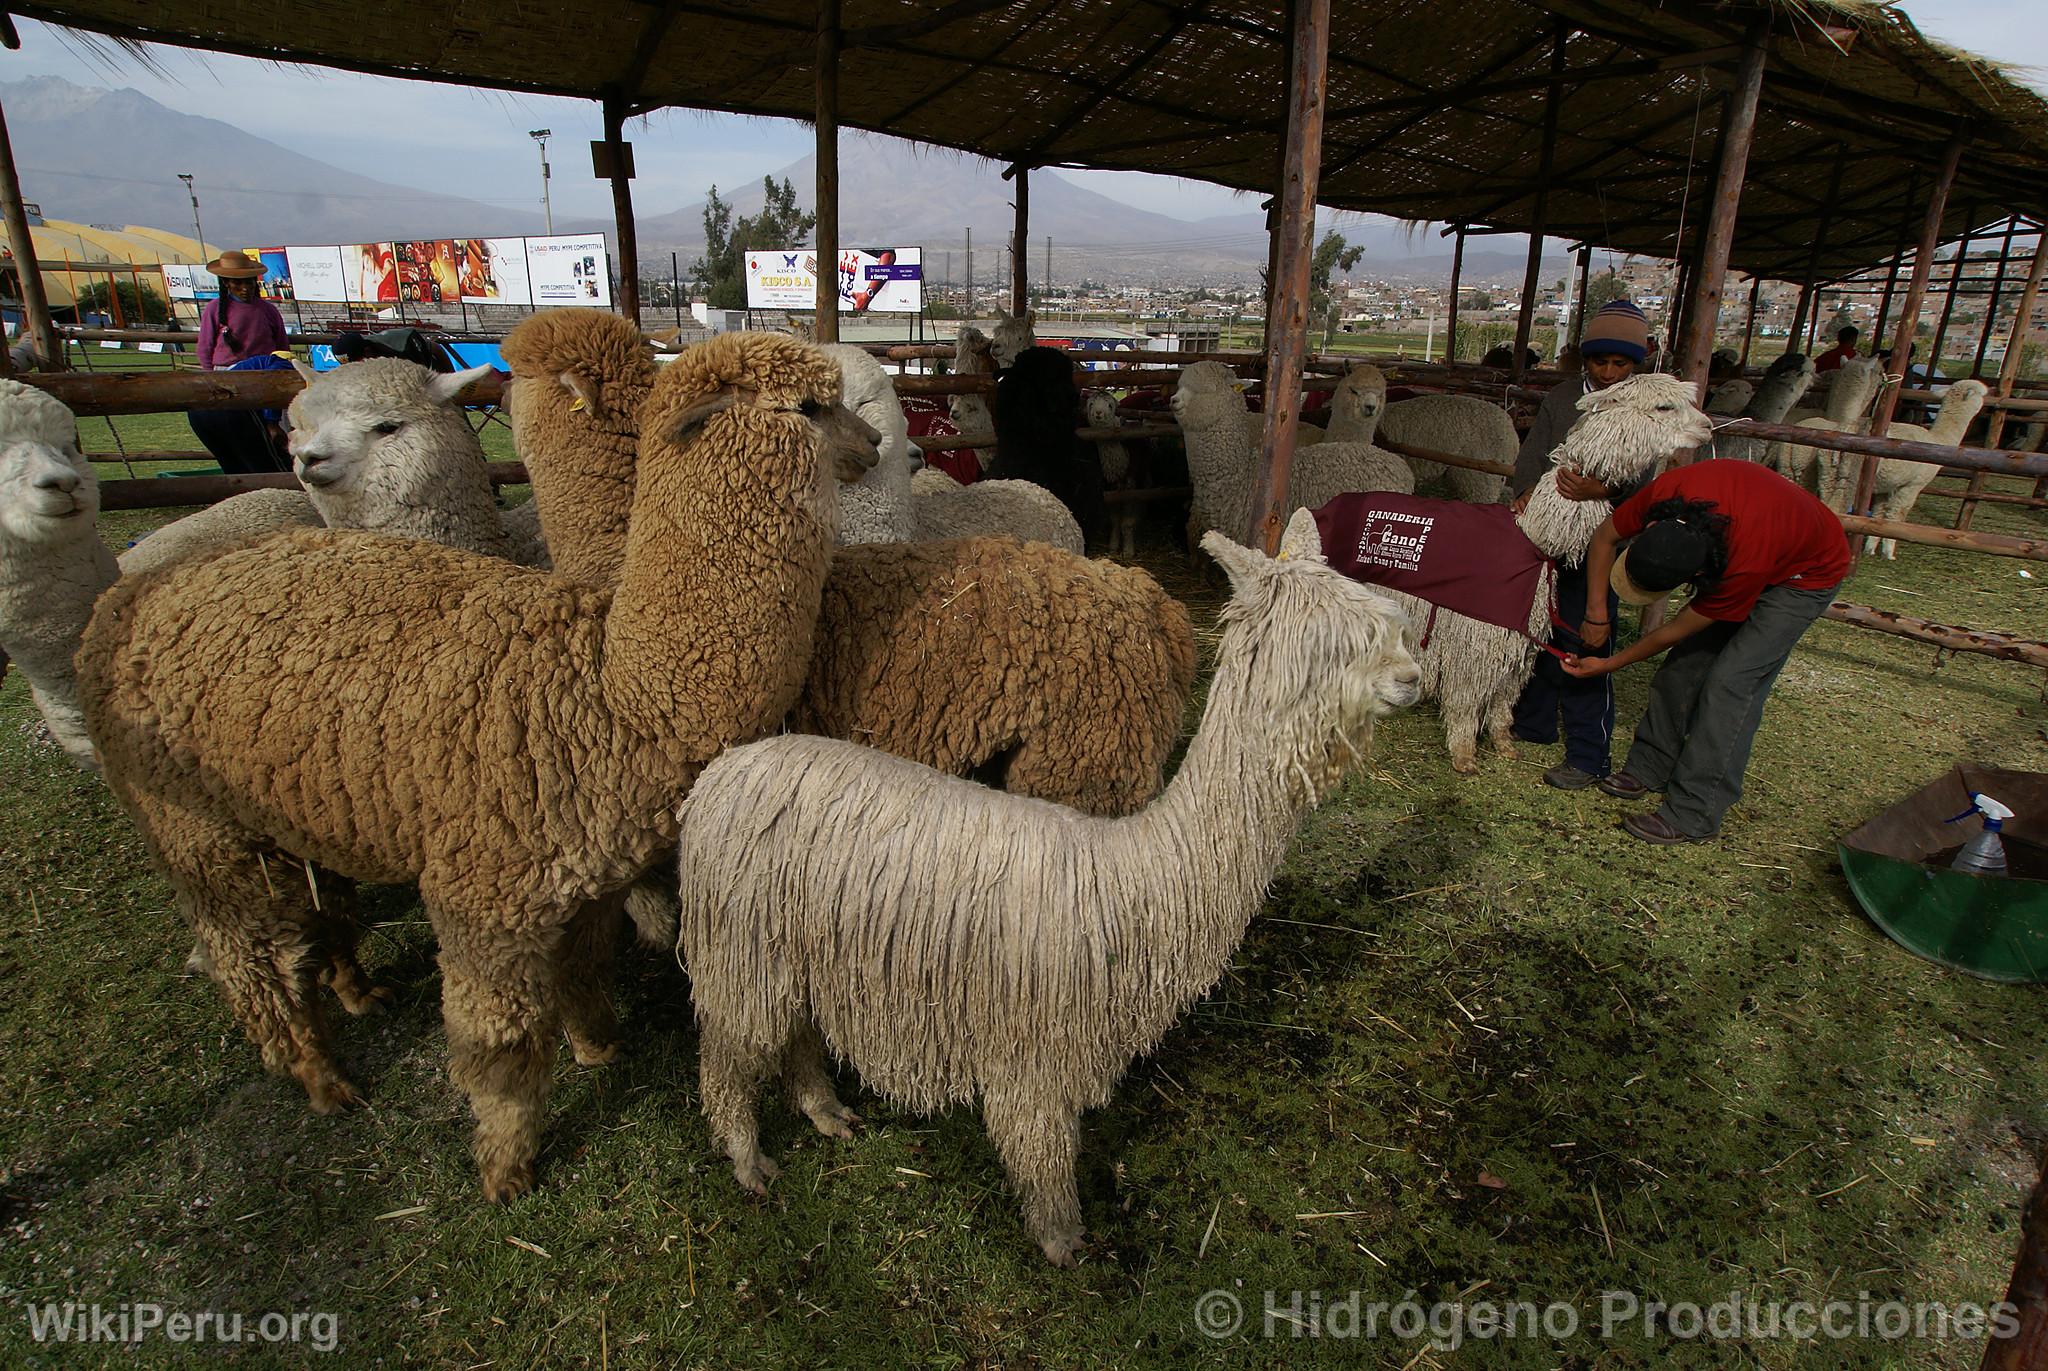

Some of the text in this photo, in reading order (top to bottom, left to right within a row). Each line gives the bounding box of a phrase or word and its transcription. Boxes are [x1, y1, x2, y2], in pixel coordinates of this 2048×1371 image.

[760, 276, 792, 287] KISCO
[841, 253, 859, 299] FedEx
[1368, 510, 1434, 526] GANADERIA
[1382, 532, 1418, 546] Cano
[1412, 526, 1432, 562] PERU
[1373, 556, 1388, 566] Cano
[1394, 560, 1418, 571] Familia
